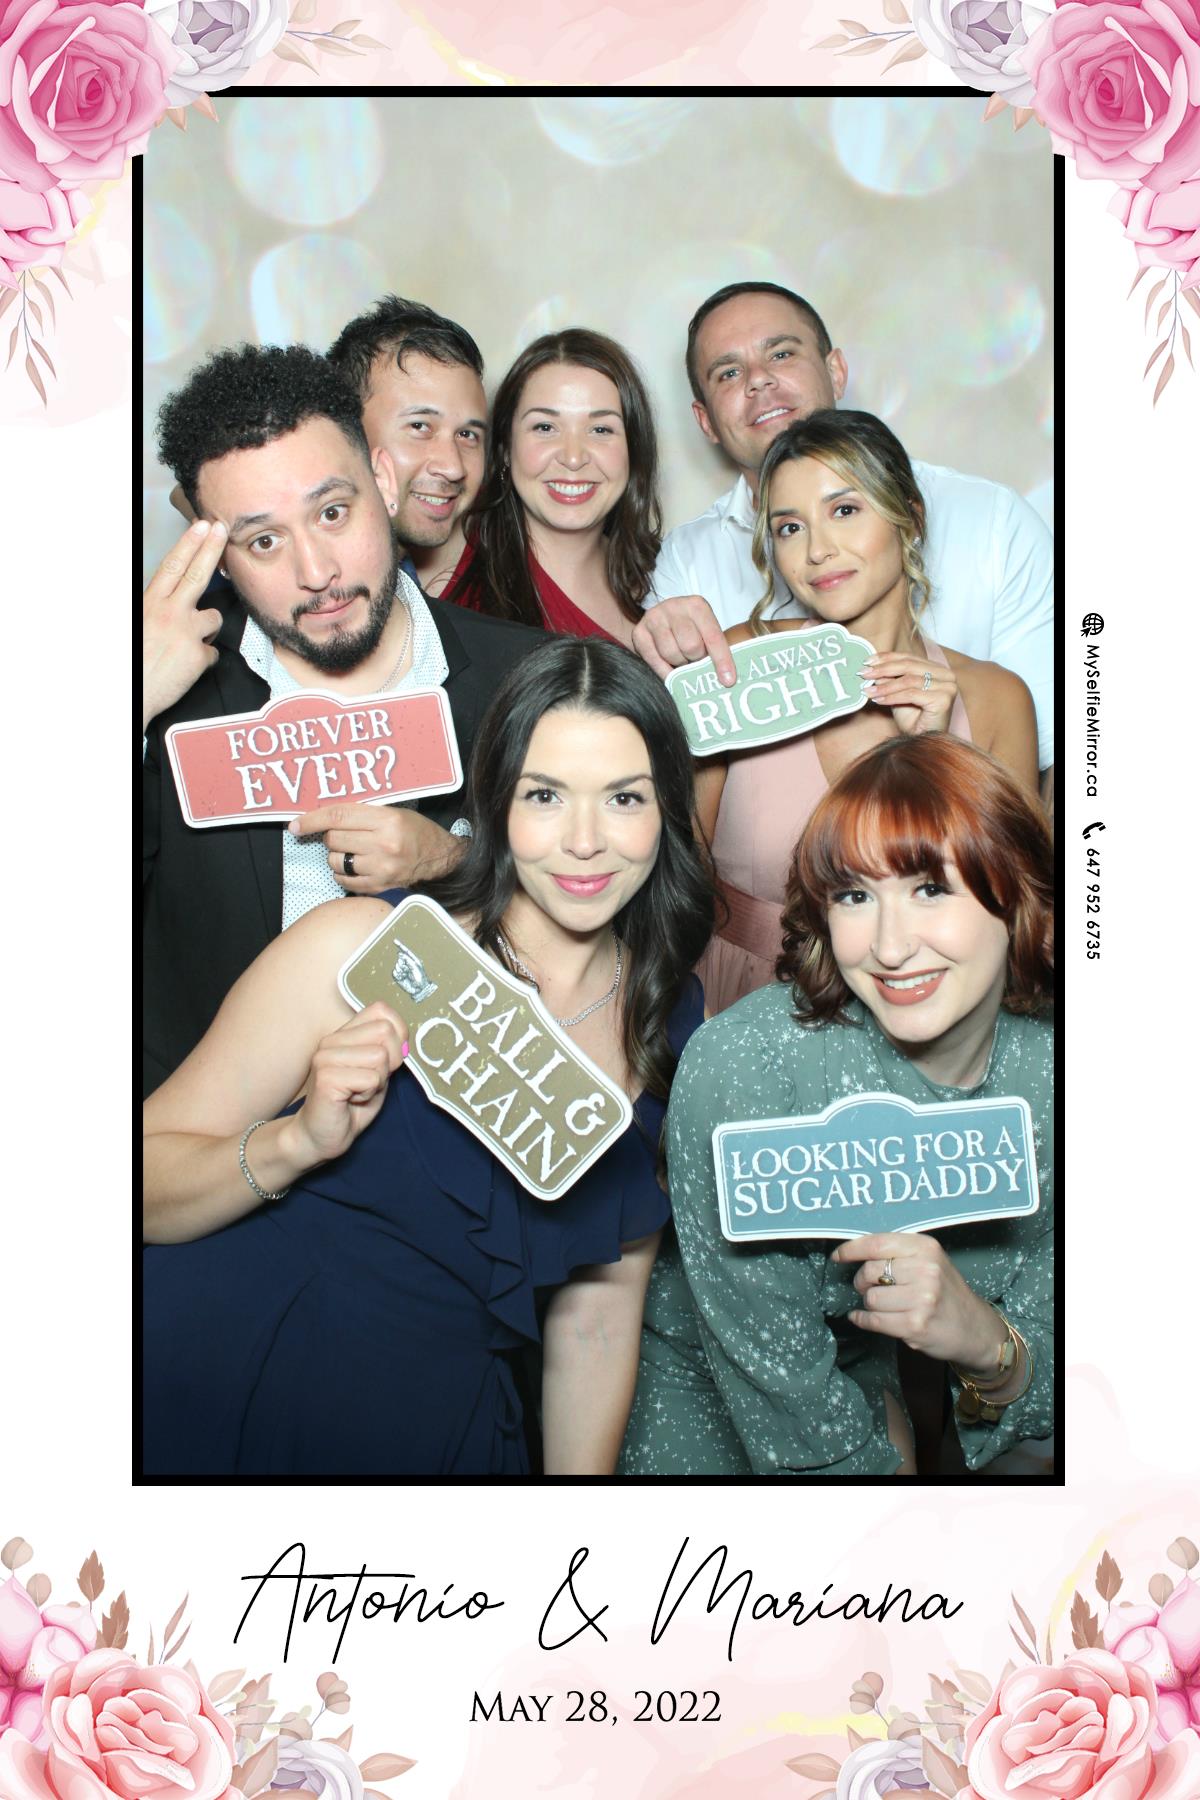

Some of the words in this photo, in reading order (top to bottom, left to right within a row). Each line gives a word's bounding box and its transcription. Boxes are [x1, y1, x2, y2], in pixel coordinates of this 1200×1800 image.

[680, 671, 741, 699] MR.
[747, 635, 842, 680] ALWAYS
[688, 657, 851, 742] RIGHT
[226, 708, 393, 760] FOREVER
[235, 745, 397, 810] EVER?
[448, 970, 568, 1105] BALL
[564, 1092, 606, 1136] &
[414, 1016, 577, 1183] CHAIN
[730, 1135, 906, 1181] LOOKING
[913, 1130, 986, 1163] FOR
[993, 1126, 1018, 1156] A
[734, 1172, 875, 1217] SUGAR
[881, 1158, 1025, 1203] DADDY
